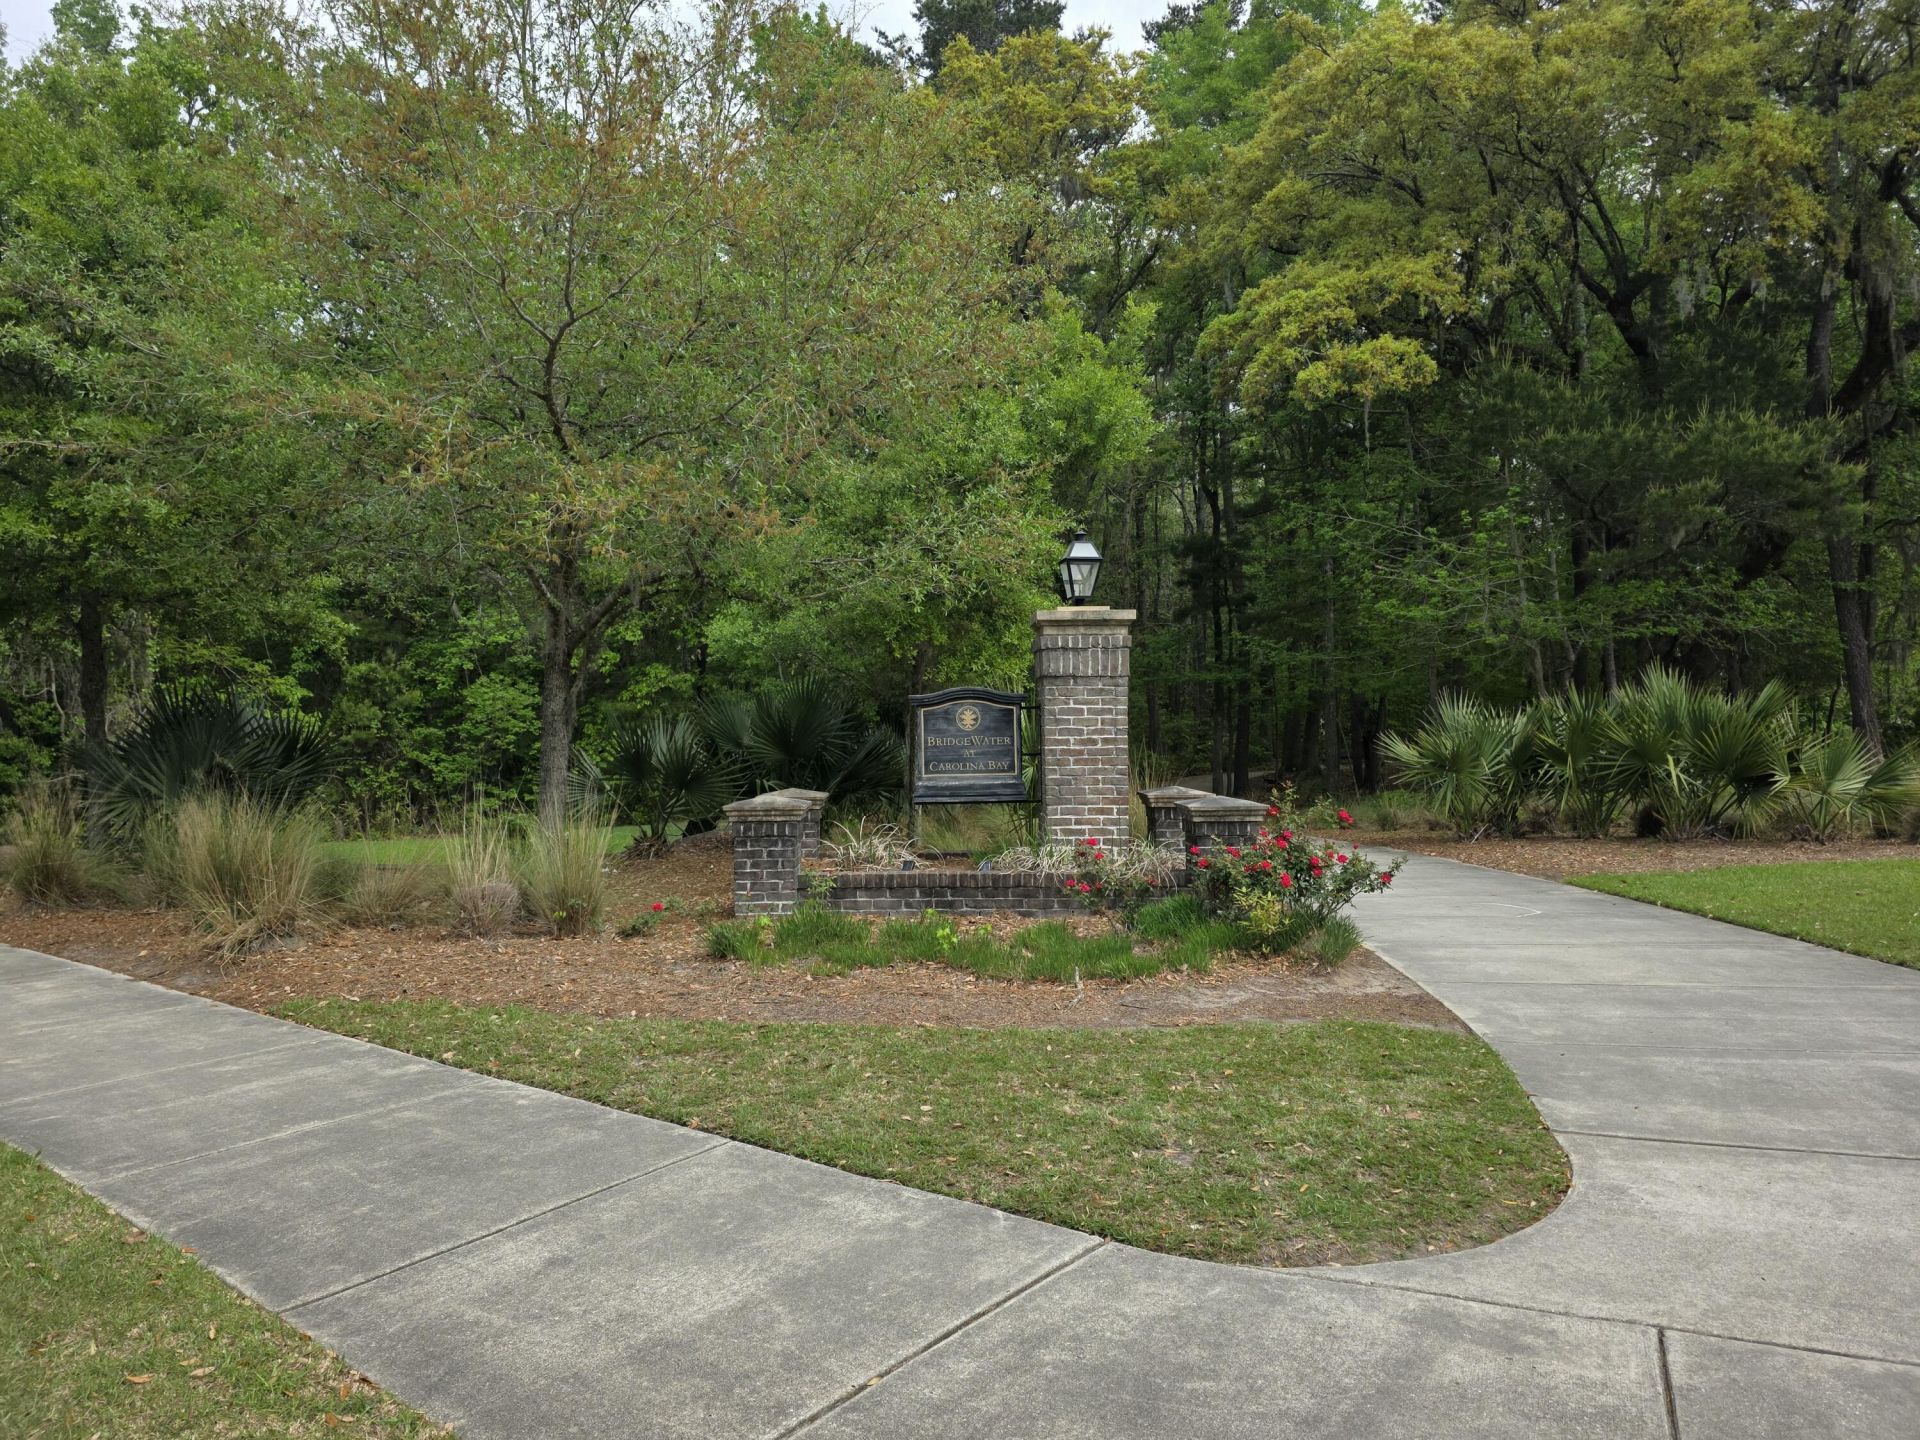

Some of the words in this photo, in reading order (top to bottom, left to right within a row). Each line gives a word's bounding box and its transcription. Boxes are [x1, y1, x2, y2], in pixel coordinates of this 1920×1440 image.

[927, 735, 1011, 746] BRIDGEWATER
[963, 749, 976, 757] AT
[929, 761, 985, 771] CAROLINA
[988, 760, 1009, 770] BAY
